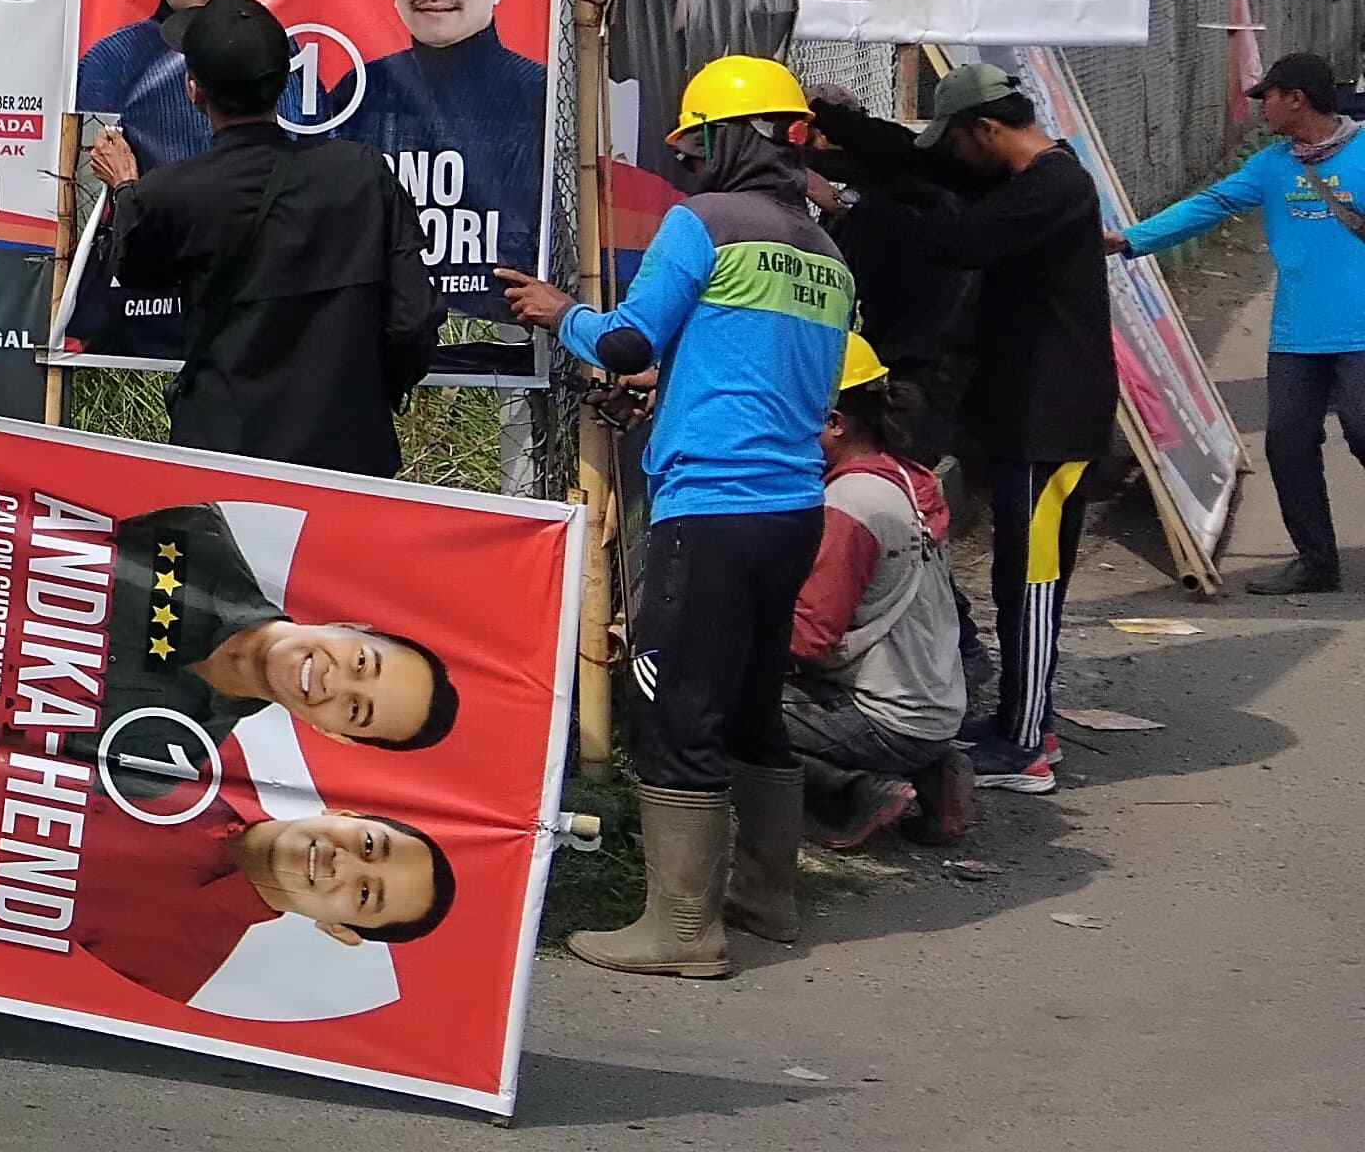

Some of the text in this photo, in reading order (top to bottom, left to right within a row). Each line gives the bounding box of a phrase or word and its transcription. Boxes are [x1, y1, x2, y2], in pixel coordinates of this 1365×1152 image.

[289, 42, 320, 116] 1
[18, 96, 43, 111] 2024
[382, 150, 464, 207] NO
[417, 208, 499, 266] ORI
[757, 251, 803, 278] AGRO
[440, 275, 489, 293] TEGAL
[125, 298, 174, 317] CALON
[119, 742, 200, 782] 1
